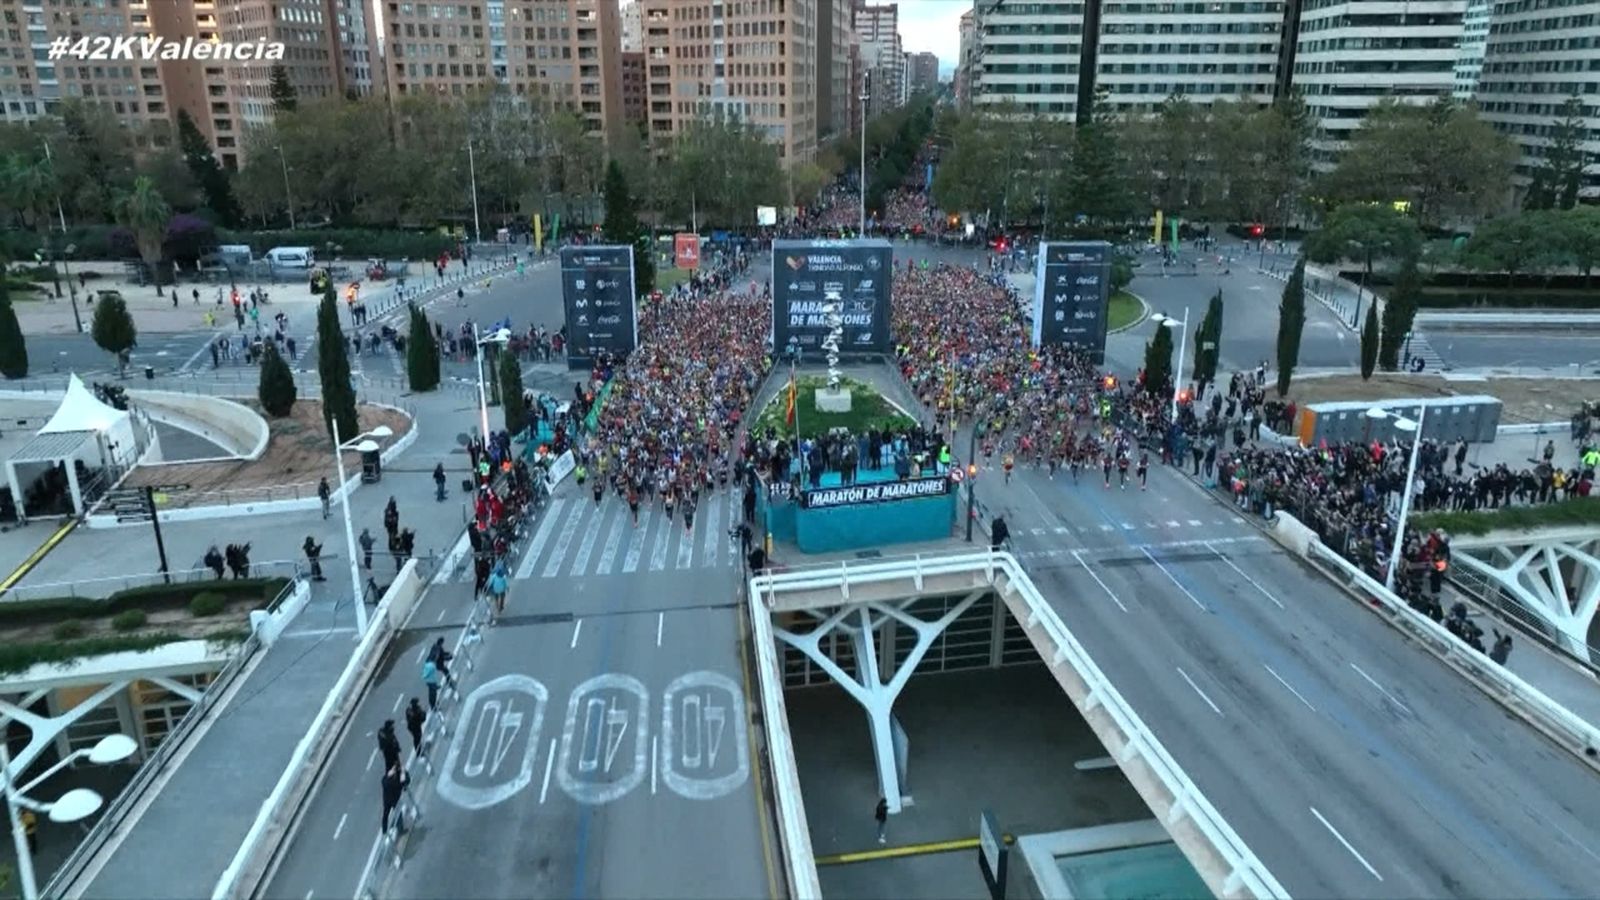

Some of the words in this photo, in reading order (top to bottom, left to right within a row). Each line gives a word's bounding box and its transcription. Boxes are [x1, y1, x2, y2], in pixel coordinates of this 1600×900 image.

[807, 255, 842, 264] VALENCIA
[790, 301, 844, 313] MARAN
[790, 314, 804, 326] DE
[807, 313, 872, 326] MATONES
[866, 487, 879, 500] DE
[882, 480, 944, 497] MARATONES
